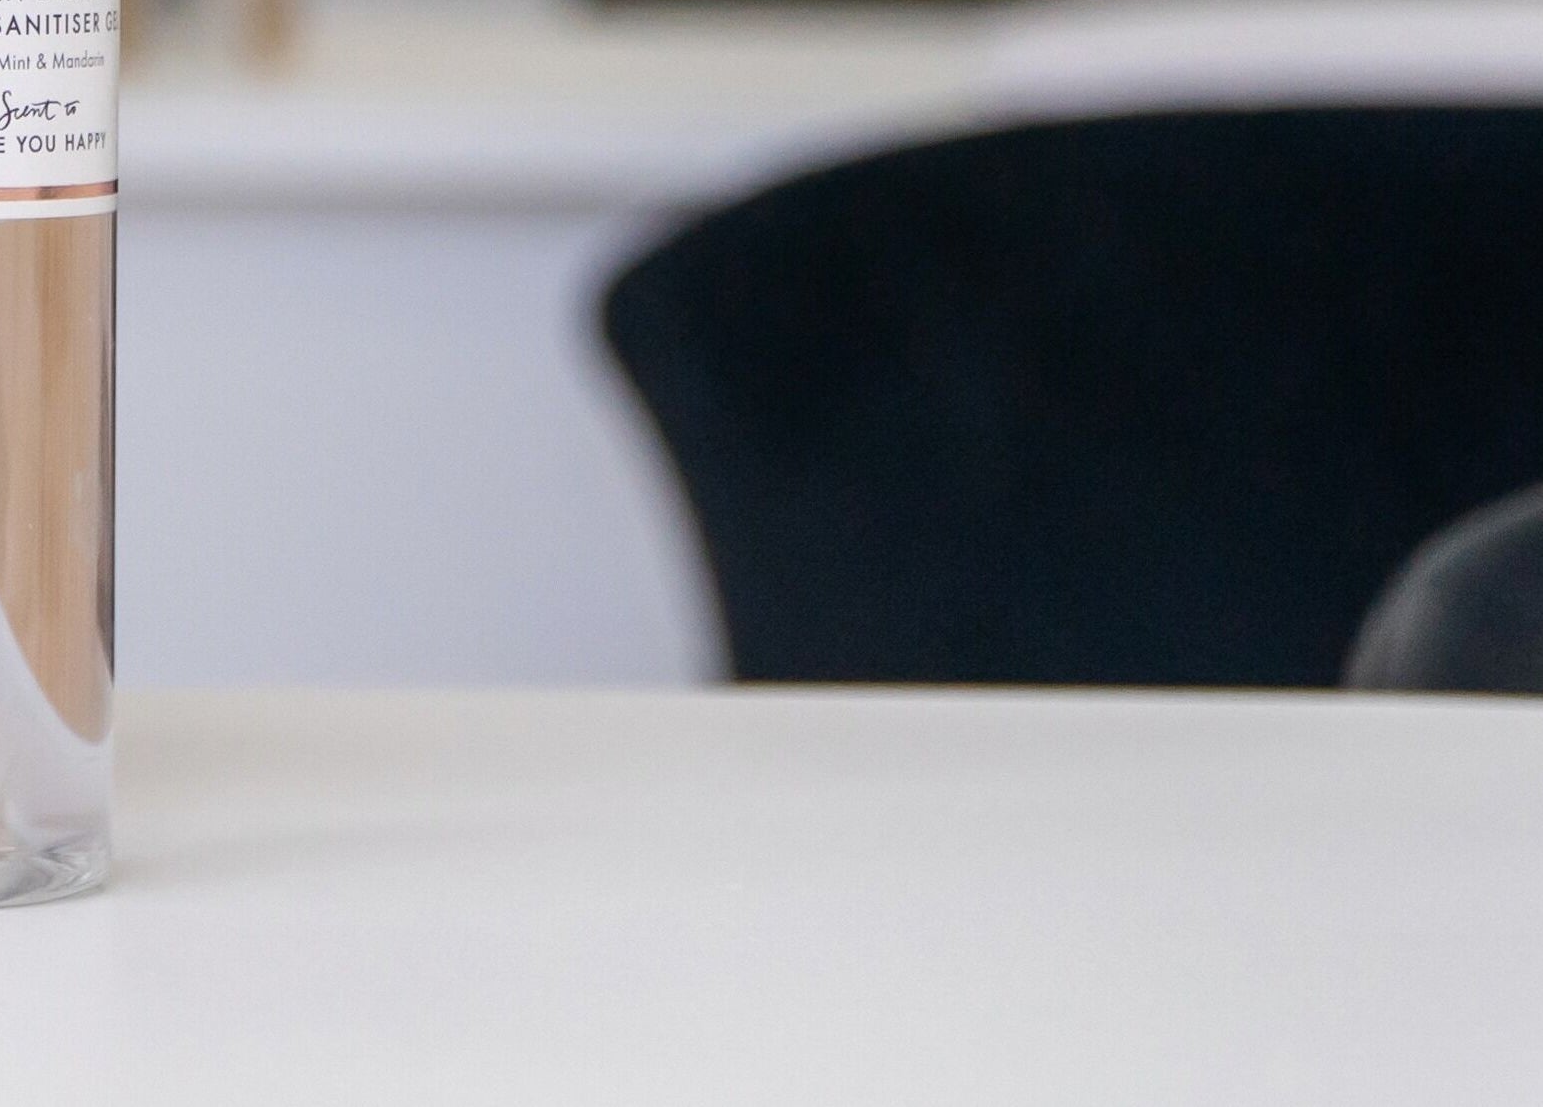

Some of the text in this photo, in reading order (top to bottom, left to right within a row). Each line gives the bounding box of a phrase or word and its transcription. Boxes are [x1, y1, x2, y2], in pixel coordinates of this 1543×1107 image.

[37, 53, 47, 69] &
[53, 50, 104, 69] Mandarin
[65, 101, 80, 115] to
[16, 135, 55, 153] YOU
[65, 133, 105, 151] HAPPY
